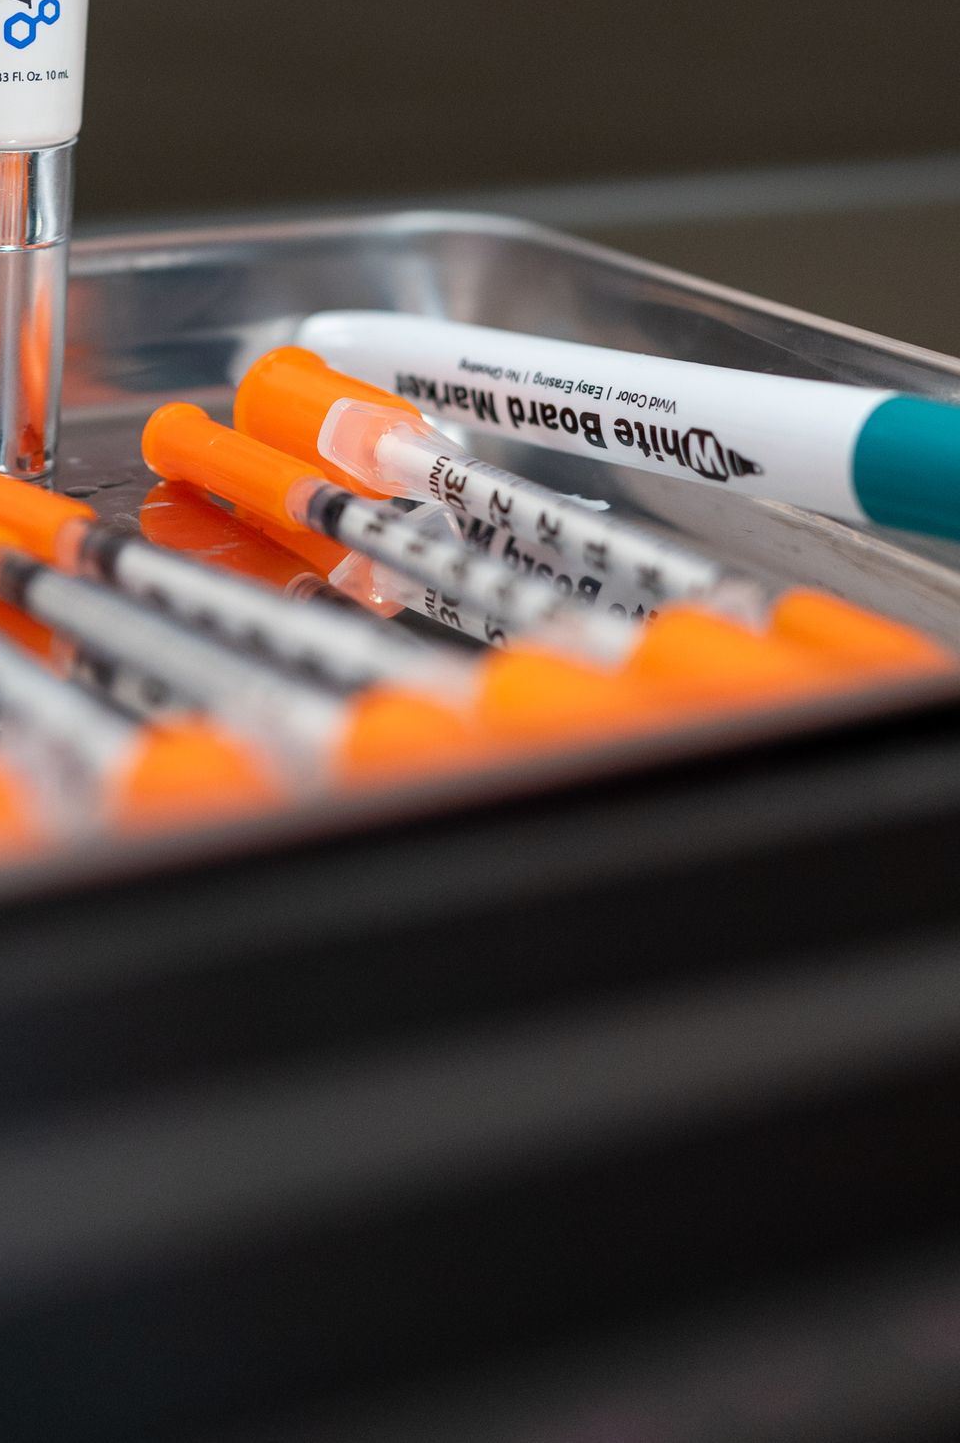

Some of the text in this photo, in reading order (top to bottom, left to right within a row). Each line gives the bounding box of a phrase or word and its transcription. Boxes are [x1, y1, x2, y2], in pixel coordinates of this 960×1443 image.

[12, 71, 25, 82] Fl.
[26, 70, 43, 82] Oz.
[46, 69, 57, 81] 10
[533, 371, 574, 394] Erasing
[575, 379, 603, 400] Easy
[615, 390, 648, 409] Color
[648, 395, 677, 415] Vivid
[507, 395, 608, 449] Board
[614, 418, 729, 482] White
